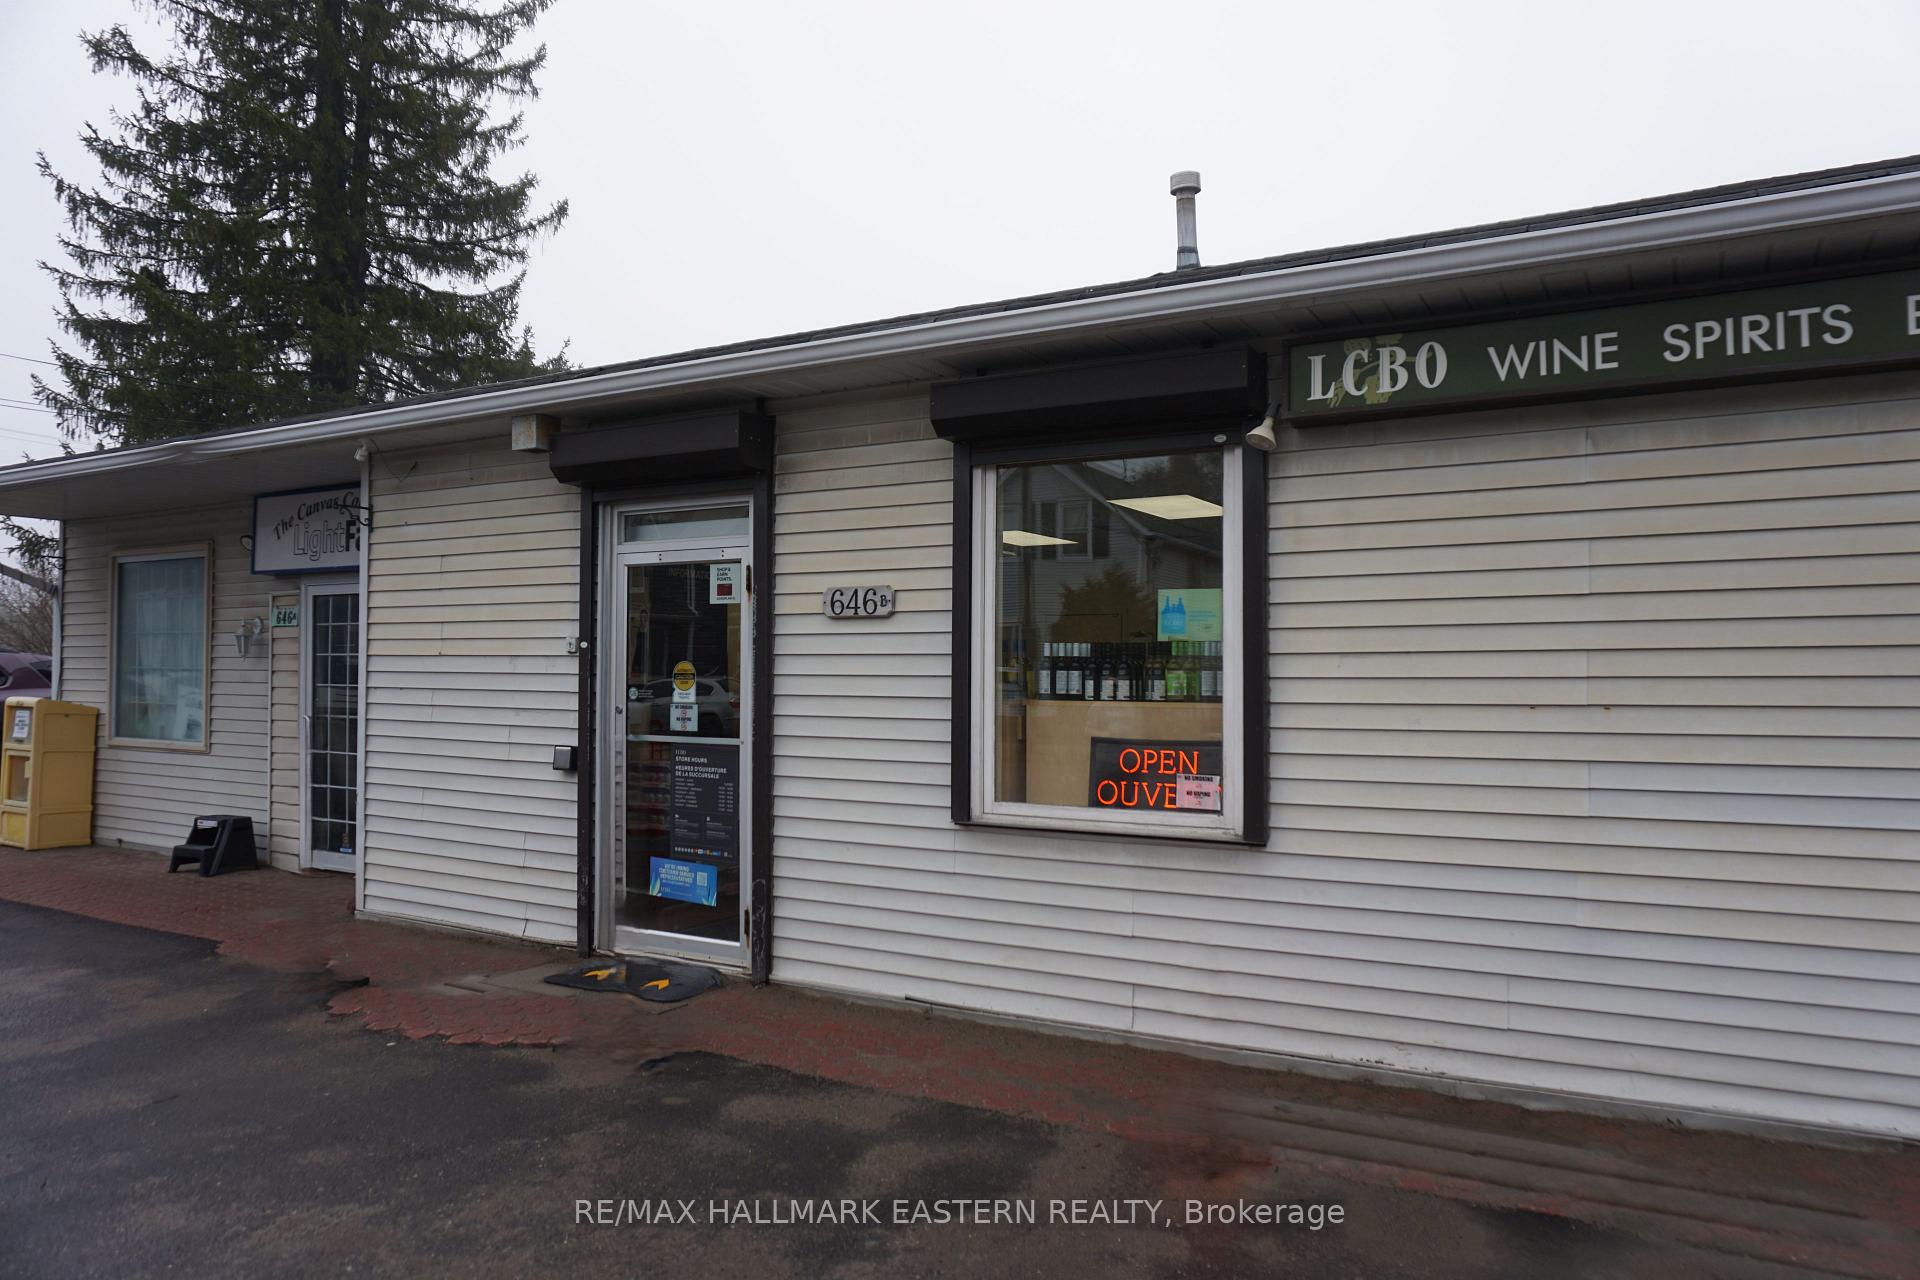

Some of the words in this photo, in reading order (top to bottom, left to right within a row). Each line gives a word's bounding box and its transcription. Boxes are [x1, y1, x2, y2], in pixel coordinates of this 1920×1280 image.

[1307, 341, 1448, 401] LCBO
[1487, 331, 1619, 382] WINE
[1663, 303, 1854, 362] SPIRITS
[273, 515, 294, 541] The
[297, 496, 339, 521] Canvas
[1120, 748, 1199, 774] OPEN
[1097, 780, 1177, 808] OUVE
